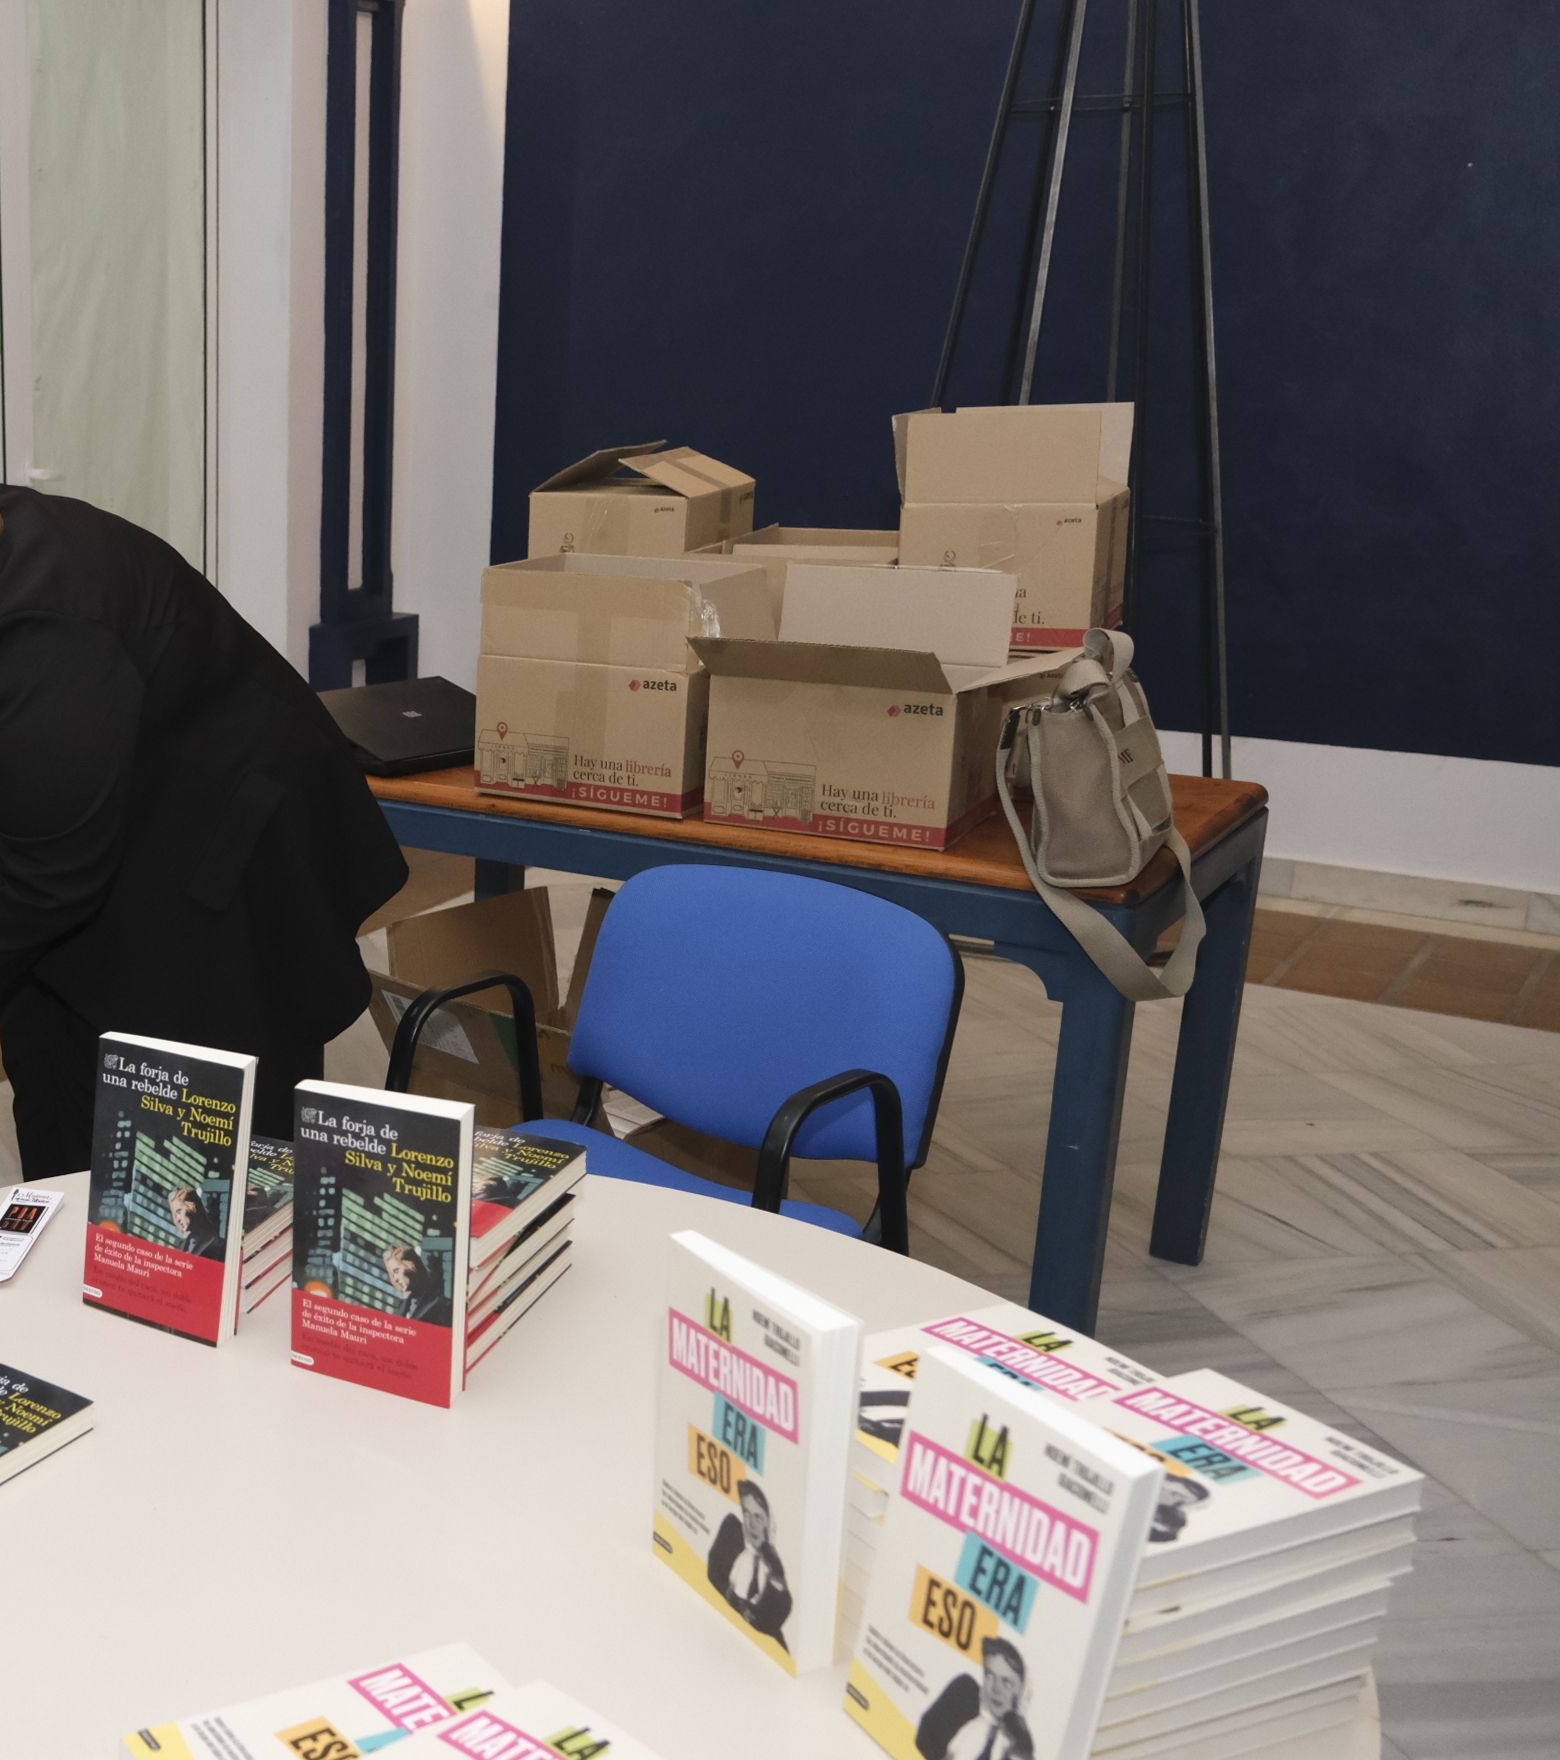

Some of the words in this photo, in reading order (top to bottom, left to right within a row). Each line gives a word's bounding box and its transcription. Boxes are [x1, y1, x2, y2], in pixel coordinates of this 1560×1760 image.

[1031, 610, 1045, 624] ti.
[642, 679, 677, 692] azeta
[903, 703, 944, 716] azeta
[573, 770, 606, 784] cerca
[608, 771, 624, 785] de
[626, 774, 639, 787] ti.
[574, 755, 598, 771] Hay
[600, 759, 623, 771] una
[625, 760, 672, 777] librería
[571, 785, 668, 808] ¡SÍGUEME!
[820, 802, 858, 815] cerca
[862, 803, 880, 817] de
[883, 806, 897, 819] ti.
[821, 784, 848, 800] Hay
[852, 788, 879, 802] una
[881, 791, 936, 810] librería
[818, 816, 931, 842] ¡SÍGUEME!
[118, 1056, 136, 1074] La
[140, 1062, 169, 1082] forja
[173, 1071, 189, 1086] de
[102, 1073, 127, 1088] una
[131, 1080, 178, 1100] rebelde
[181, 1088, 237, 1114] Lorenzo
[140, 1095, 174, 1116] Silva
[177, 1109, 186, 1121] y
[189, 1106, 234, 1130] Noemí
[317, 1110, 337, 1128] La
[342, 1116, 376, 1137] forja
[380, 1124, 399, 1141] de
[180, 1121, 233, 1147] Trujillo
[300, 1127, 328, 1143] una
[332, 1133, 387, 1155] rebelde
[391, 1142, 454, 1169] Lorenzo
[504, 1153, 557, 1169] Trujillo
[513, 1143, 570, 1160] Lorenzo
[516, 1149, 566, 1165] Noemí
[344, 1151, 383, 1173] Silva
[387, 1163, 397, 1176] y
[402, 1162, 453, 1186] Noemí
[392, 1177, 452, 1203] Trujillo
[94, 1243, 104, 1253] de
[104, 1245, 122, 1259] éxito
[124, 1252, 133, 1262] de
[134, 1255, 142, 1265] la
[143, 1258, 182, 1278] inspectora
[94, 1253, 125, 1270] Manuela
[126, 1264, 150, 1278] Mauri
[95, 1233, 104, 1243] El
[105, 1239, 135, 1253] segundo
[136, 1248, 153, 1258] caso
[154, 1251, 164, 1261] de
[165, 1254, 174, 1265] la
[174, 1259, 194, 1271] serie
[301, 1309, 312, 1319] de
[313, 1312, 335, 1326] éxito
[336, 1318, 346, 1328] de
[348, 1321, 357, 1332] la
[359, 1324, 405, 1344] inspectora
[302, 1298, 312, 1308] El
[313, 1303, 349, 1319] segundo
[350, 1313, 370, 1324] caso
[371, 1317, 382, 1327] de
[384, 1320, 393, 1330] la
[394, 1325, 417, 1336] serie
[708, 1286, 732, 1343] LA
[302, 1319, 338, 1337] Manuela
[340, 1330, 367, 1344] Mauri
[1023, 1331, 1075, 1353] LA
[672, 1315, 795, 1432] MATERNIDAD
[12, 1383, 29, 1393] de
[5, 1402, 53, 1427] Noemí
[8, 1391, 62, 1419] Lorenzo
[1230, 1405, 1287, 1432] LA
[723, 1400, 759, 1470] ERA
[972, 1413, 1009, 1478] LA
[1124, 1390, 1348, 1496] MATERNIDAD
[695, 1432, 732, 1495] ESO
[1171, 1442, 1248, 1482] ERA
[907, 1441, 1091, 1590] MATERNIDAD
[968, 1545, 1028, 1627] ERA
[922, 1577, 977, 1651] ESO
